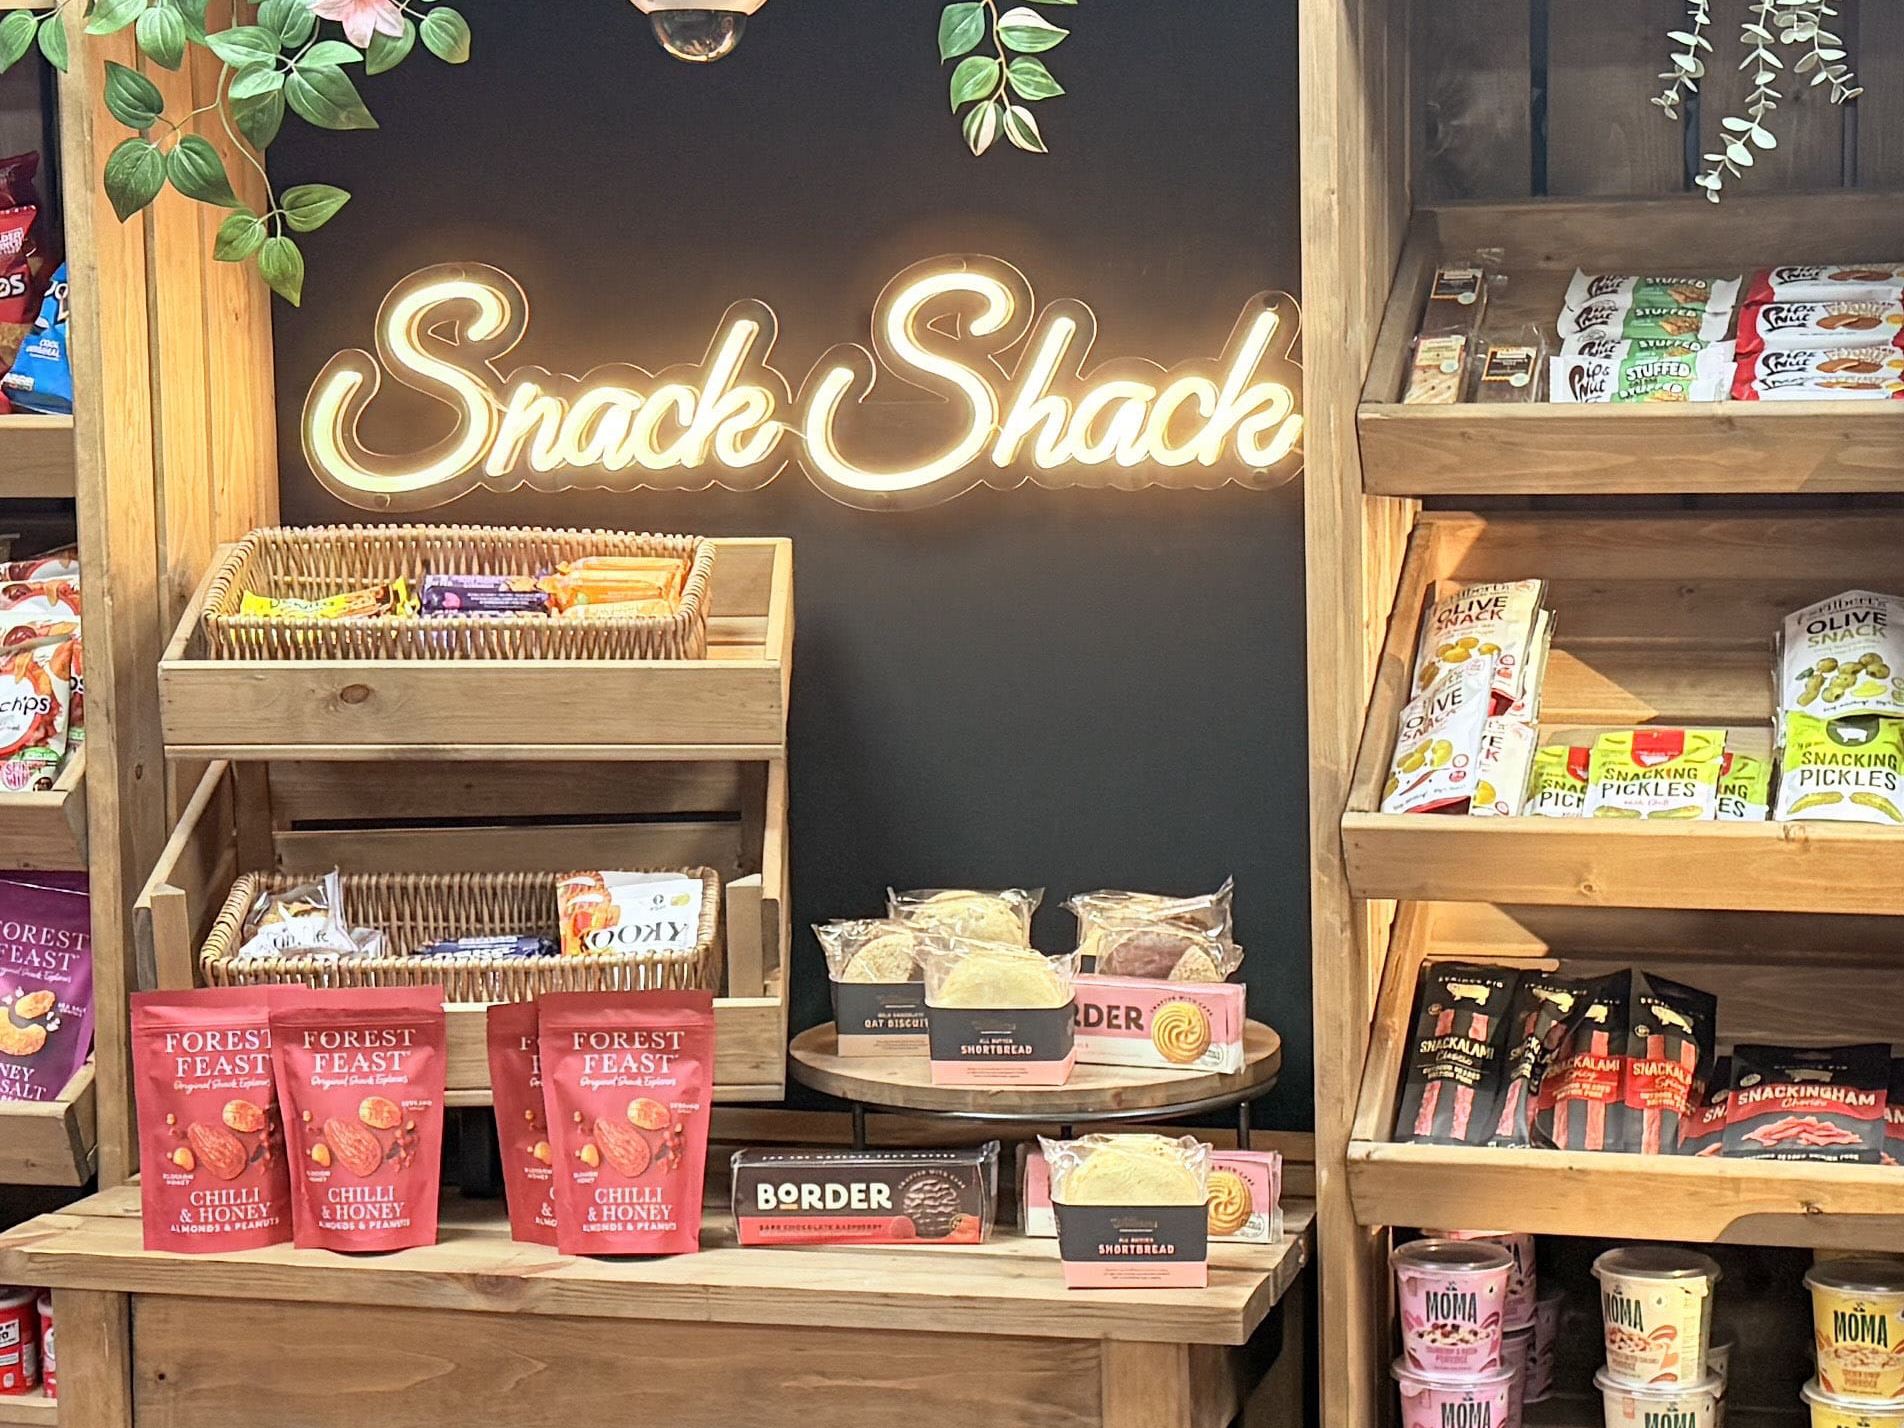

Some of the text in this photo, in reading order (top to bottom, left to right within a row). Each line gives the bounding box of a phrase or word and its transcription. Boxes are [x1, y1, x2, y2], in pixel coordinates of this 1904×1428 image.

[1646, 277, 1707, 290] STUFFED
[1635, 307, 1698, 318] STUFFED
[1638, 339, 1703, 352] STUFFED
[1626, 361, 1691, 382] STUFFED
[310, 270, 1304, 496] Snack Shack
[1436, 608, 1504, 632] SNACK
[1437, 595, 1509, 624] OLIVE
[1806, 611, 1887, 635] OLIVE
[1807, 623, 1887, 648] SNACK
[1801, 749, 1898, 769] SNACKING
[1603, 767, 1698, 782] SNACKING
[1799, 768, 1897, 791] PICKLES
[1601, 781, 1696, 798] PICKLES
[864, 1018, 885, 1029] OAT
[303, 1028, 416, 1049] FOREST
[572, 1031, 686, 1051] FOREST
[1419, 1035, 1495, 1060] SNACKALAMI
[960, 1044, 1033, 1056] SHORTBREAD
[176, 1053, 270, 1079] FEAST
[312, 1051, 404, 1074] FEAST
[582, 1053, 674, 1075] FEAST
[0, 1079, 47, 1101] SALT
[1737, 1085, 1876, 1107] SNACKINGHAM
[189, 1187, 261, 1207] CHILLI
[327, 1185, 395, 1204] CHILLI
[594, 1187, 663, 1205] CHILLI
[756, 1182, 893, 1211] BORDER
[179, 1202, 272, 1224] & HONEY
[321, 1202, 405, 1221] & HONEY
[587, 1204, 673, 1222] & HONEY
[170, 1222, 221, 1234] ALMONDS
[1098, 1243, 1175, 1256] SHORTBREAD
[1425, 1290, 1478, 1325] MOMA
[1833, 1309, 1889, 1350] MOMA
